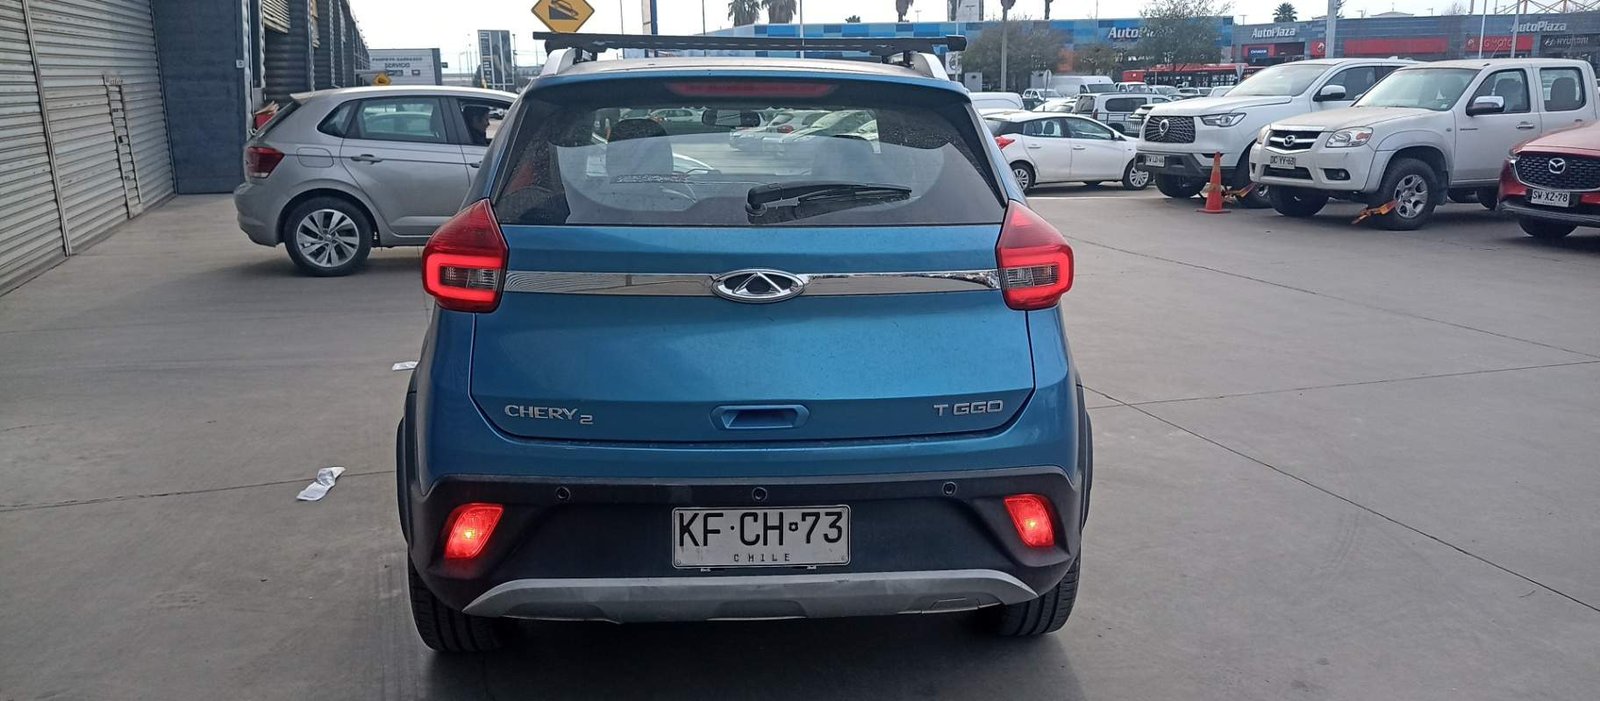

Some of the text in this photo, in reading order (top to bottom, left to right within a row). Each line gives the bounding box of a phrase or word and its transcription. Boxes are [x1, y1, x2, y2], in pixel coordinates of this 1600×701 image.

[1511, 20, 1567, 32] AutoPlaza
[1252, 27, 1296, 38] AutoPlaza
[504, 404, 594, 426] CHERY 2
[733, 553, 791, 562] CHILE
